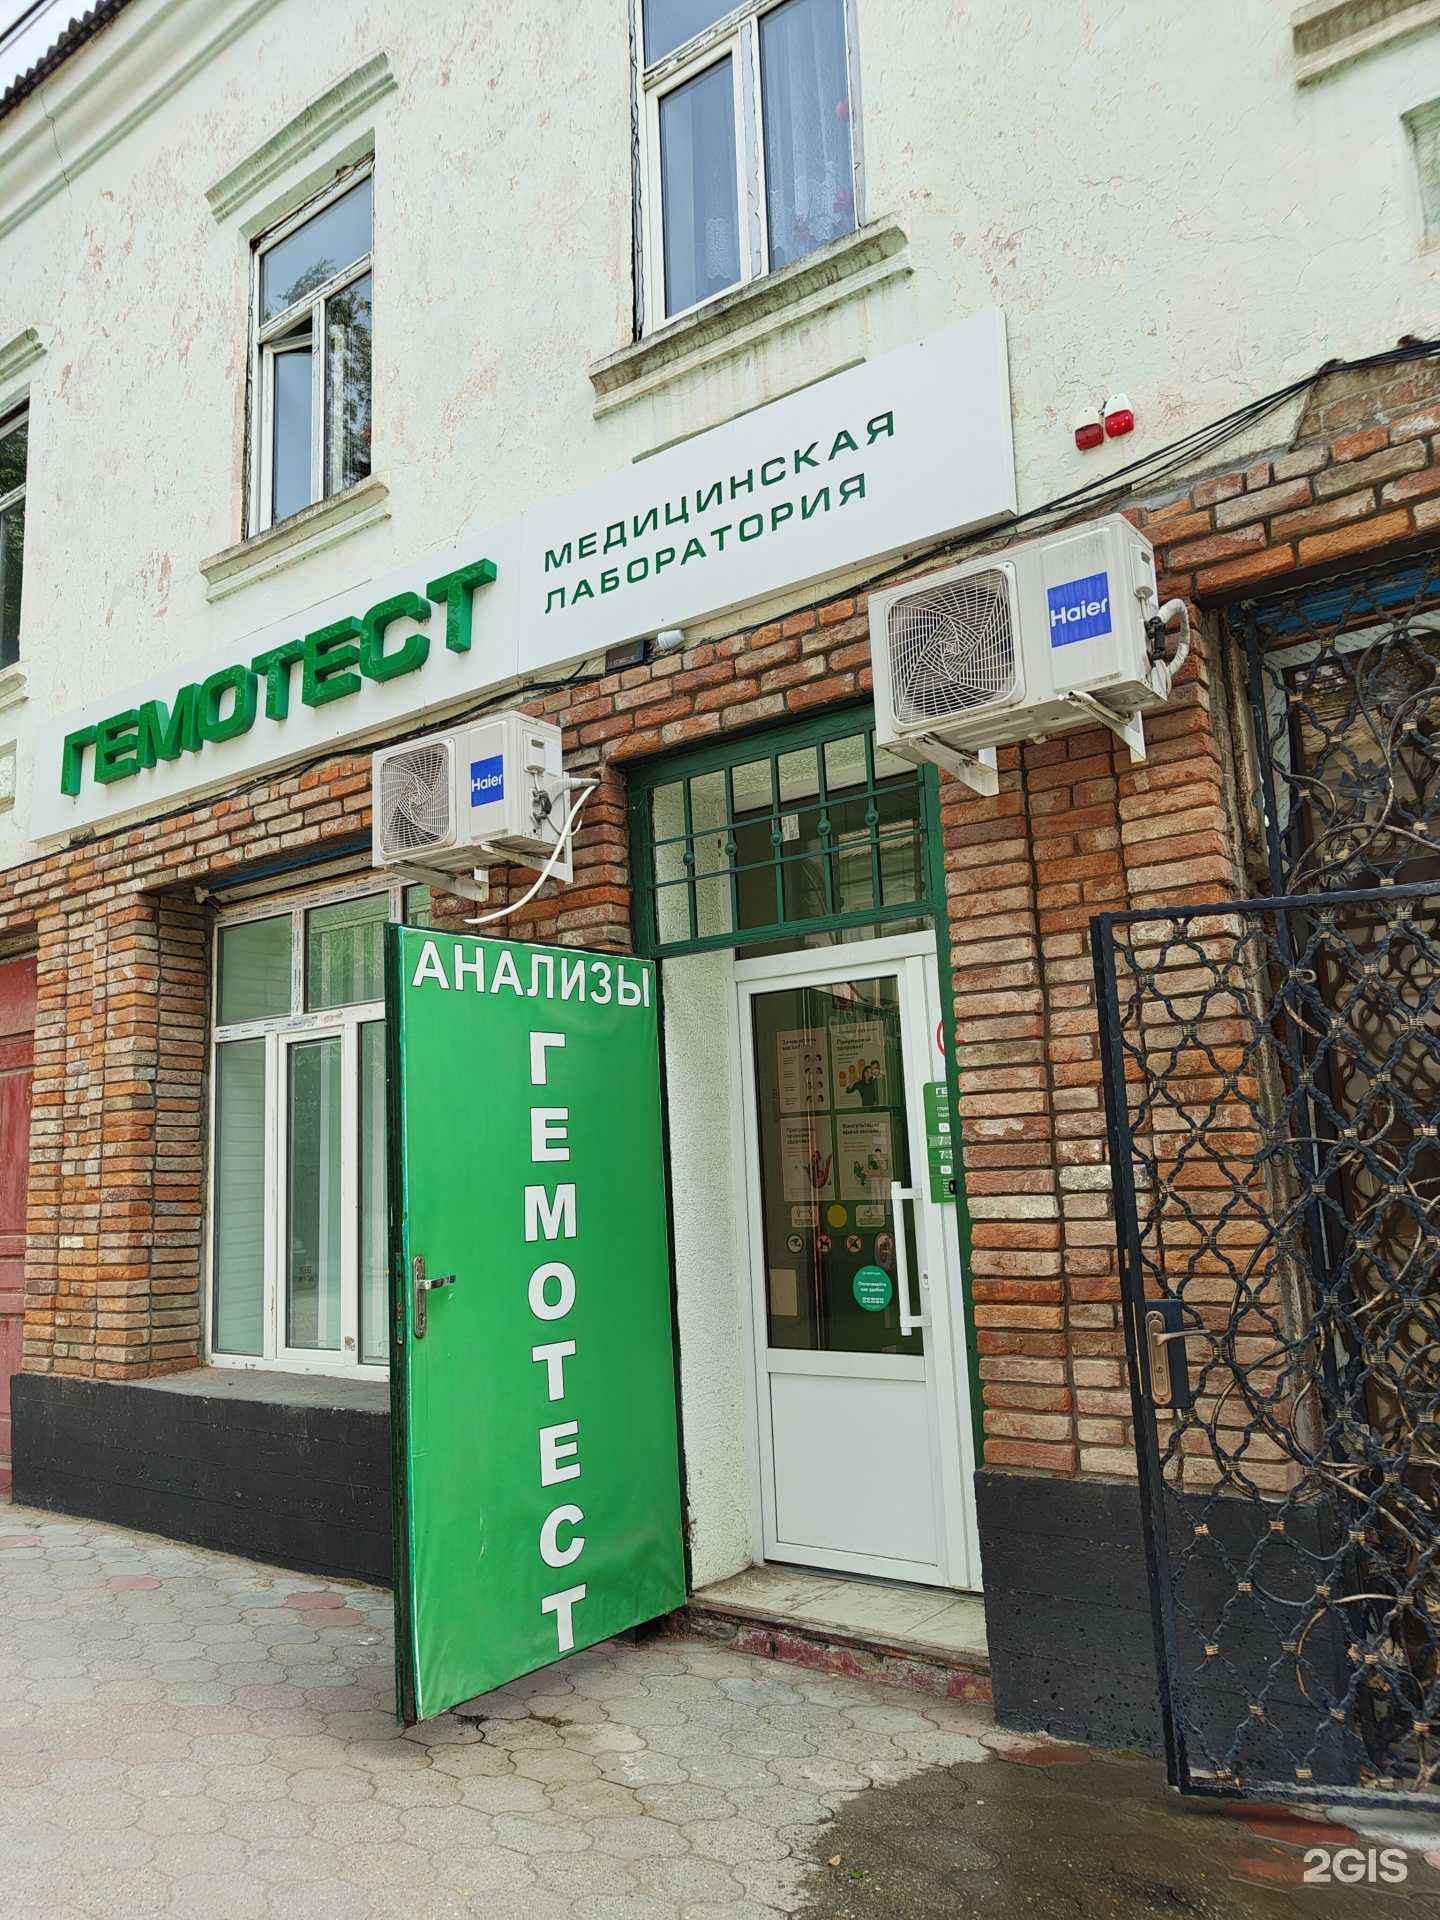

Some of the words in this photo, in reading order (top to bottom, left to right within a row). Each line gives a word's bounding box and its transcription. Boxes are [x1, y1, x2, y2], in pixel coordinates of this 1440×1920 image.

[544, 410, 895, 572] МЕДИЦИНСКАЯ
[544, 472, 867, 614] ЛАБОРАТОРИЯ
[60, 558, 498, 797] ГЕМОТЕСТ
[1050, 598, 1109, 627] Haier
[471, 774, 503, 792] Haier
[411, 940, 652, 1008] АНАЛИЗЫ
[523, 1031, 587, 1654] ГЕМОТЕСТ
